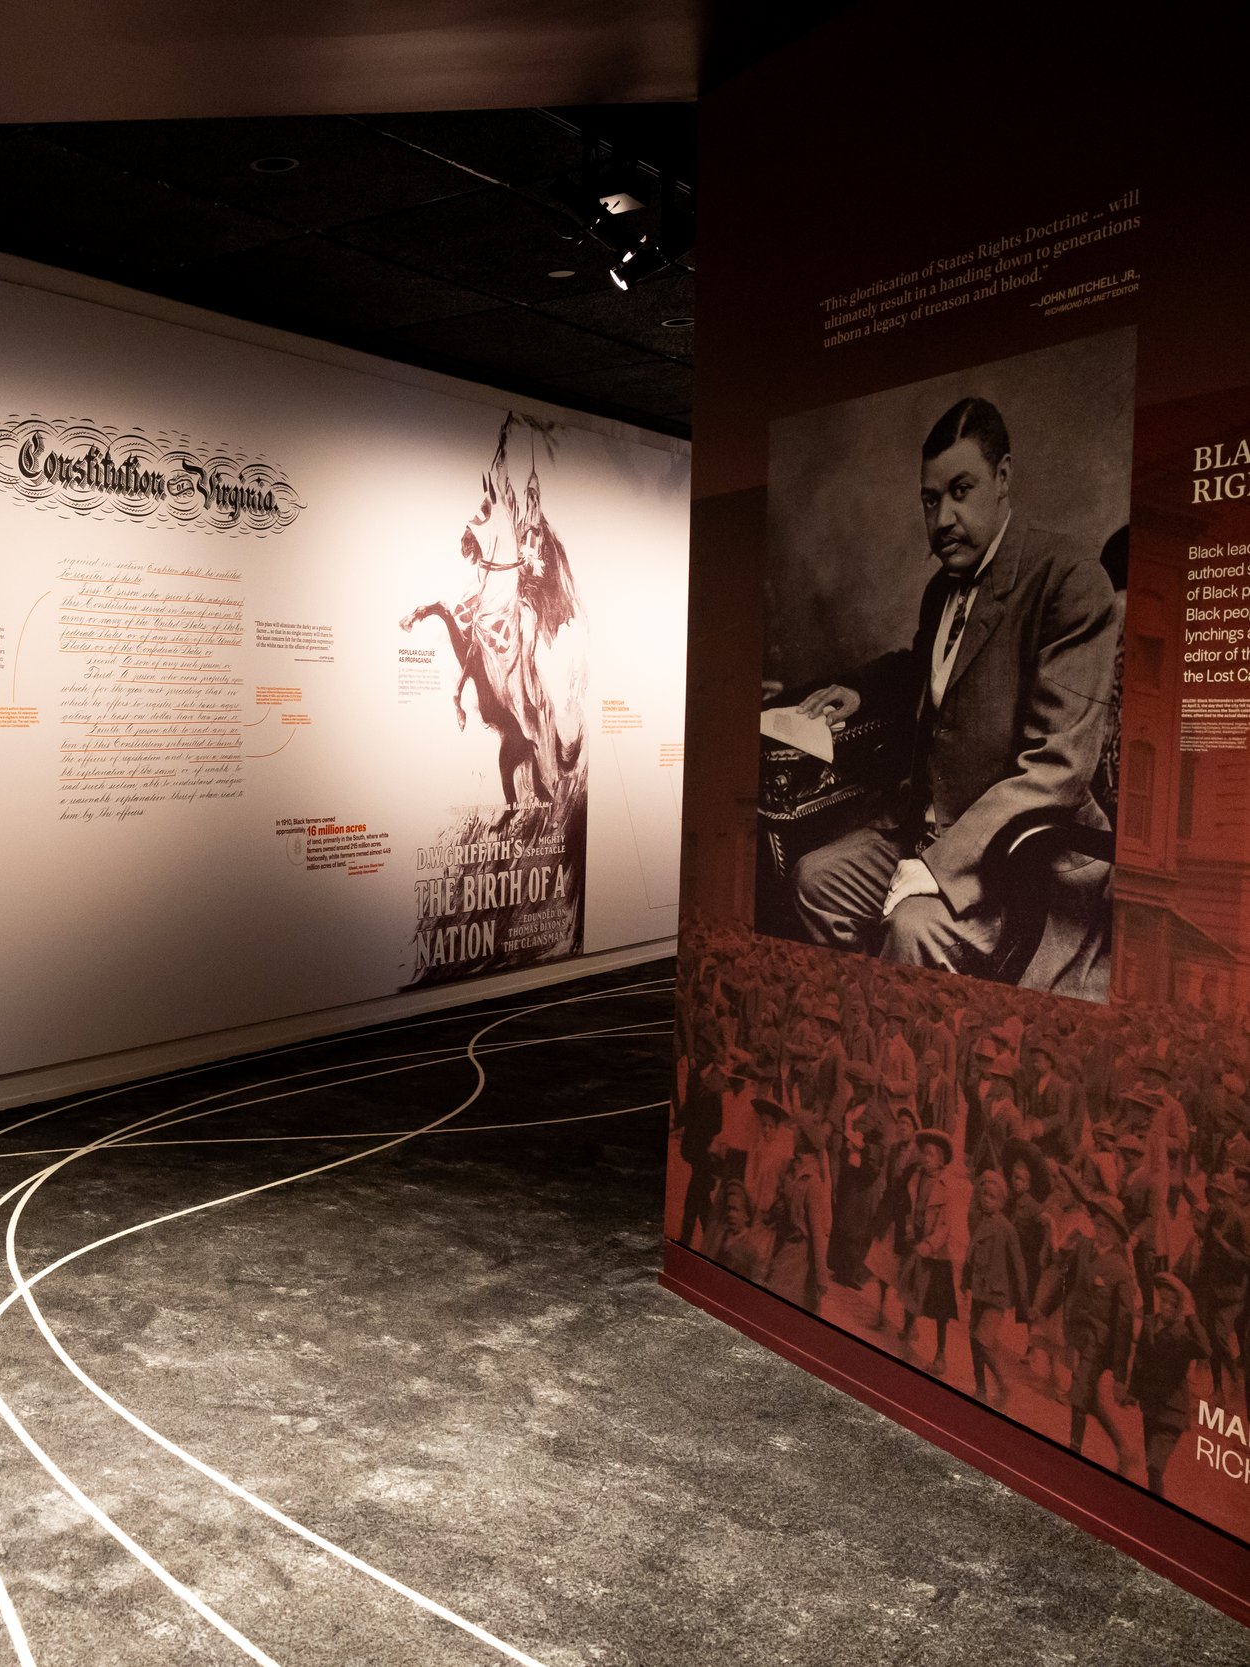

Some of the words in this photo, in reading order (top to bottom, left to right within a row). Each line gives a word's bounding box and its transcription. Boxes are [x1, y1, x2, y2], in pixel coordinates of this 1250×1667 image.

[849, 271, 919, 307] glorification
[921, 260, 935, 279] of
[936, 251, 975, 273] States
[978, 236, 1022, 259] Rights
[1025, 211, 1089, 243] Doctrine
[1108, 188, 1140, 212] will
[824, 302, 878, 330] ultimately
[880, 290, 913, 312] result
[915, 286, 927, 300] in
[929, 284, 937, 295] a
[939, 266, 992, 292] handing
[994, 252, 1033, 273] down
[1036, 246, 1050, 260] to
[1053, 216, 1141, 258] generations
[1067, 274, 1119, 298] MITCHELL
[1044, 299, 1082, 317] RICHMOND
[1083, 290, 1111, 306] PLANET
[1111, 283, 1140, 298] EDITOR
[823, 328, 861, 349] unborn
[864, 325, 871, 336] a
[873, 313, 908, 334] legacy
[910, 304, 924, 321] of
[925, 293, 970, 316] treason
[973, 280, 997, 301] and
[18, 430, 167, 500] Constitution
[1191, 472, 1250, 504] RIG
[1188, 543, 1224, 560] Black
[1187, 562, 1245, 581] authored
[1186, 587, 1201, 601] of
[1202, 584, 1239, 600] Black
[1186, 606, 1221, 621] Black
[1184, 627, 1245, 645] lynchings
[1184, 648, 1221, 662] editor
[1224, 647, 1239, 662] of
[1183, 669, 1204, 683] the
[1206, 668, 1235, 683] Lost
[293, 817, 305, 825] Black
[307, 825, 317, 837] 16
[318, 824, 345, 836] million
[345, 823, 367, 833] acres
[538, 834, 566, 845] MIGHTY
[526, 844, 566, 857] SPECTACLE
[414, 877, 456, 920] THE
[463, 869, 523, 913] BIRTH
[528, 865, 551, 903] OF
[553, 864, 566, 899] A
[508, 924, 539, 938] THOMAS
[416, 920, 495, 970] NATION
[1198, 1399, 1250, 1448] MA
